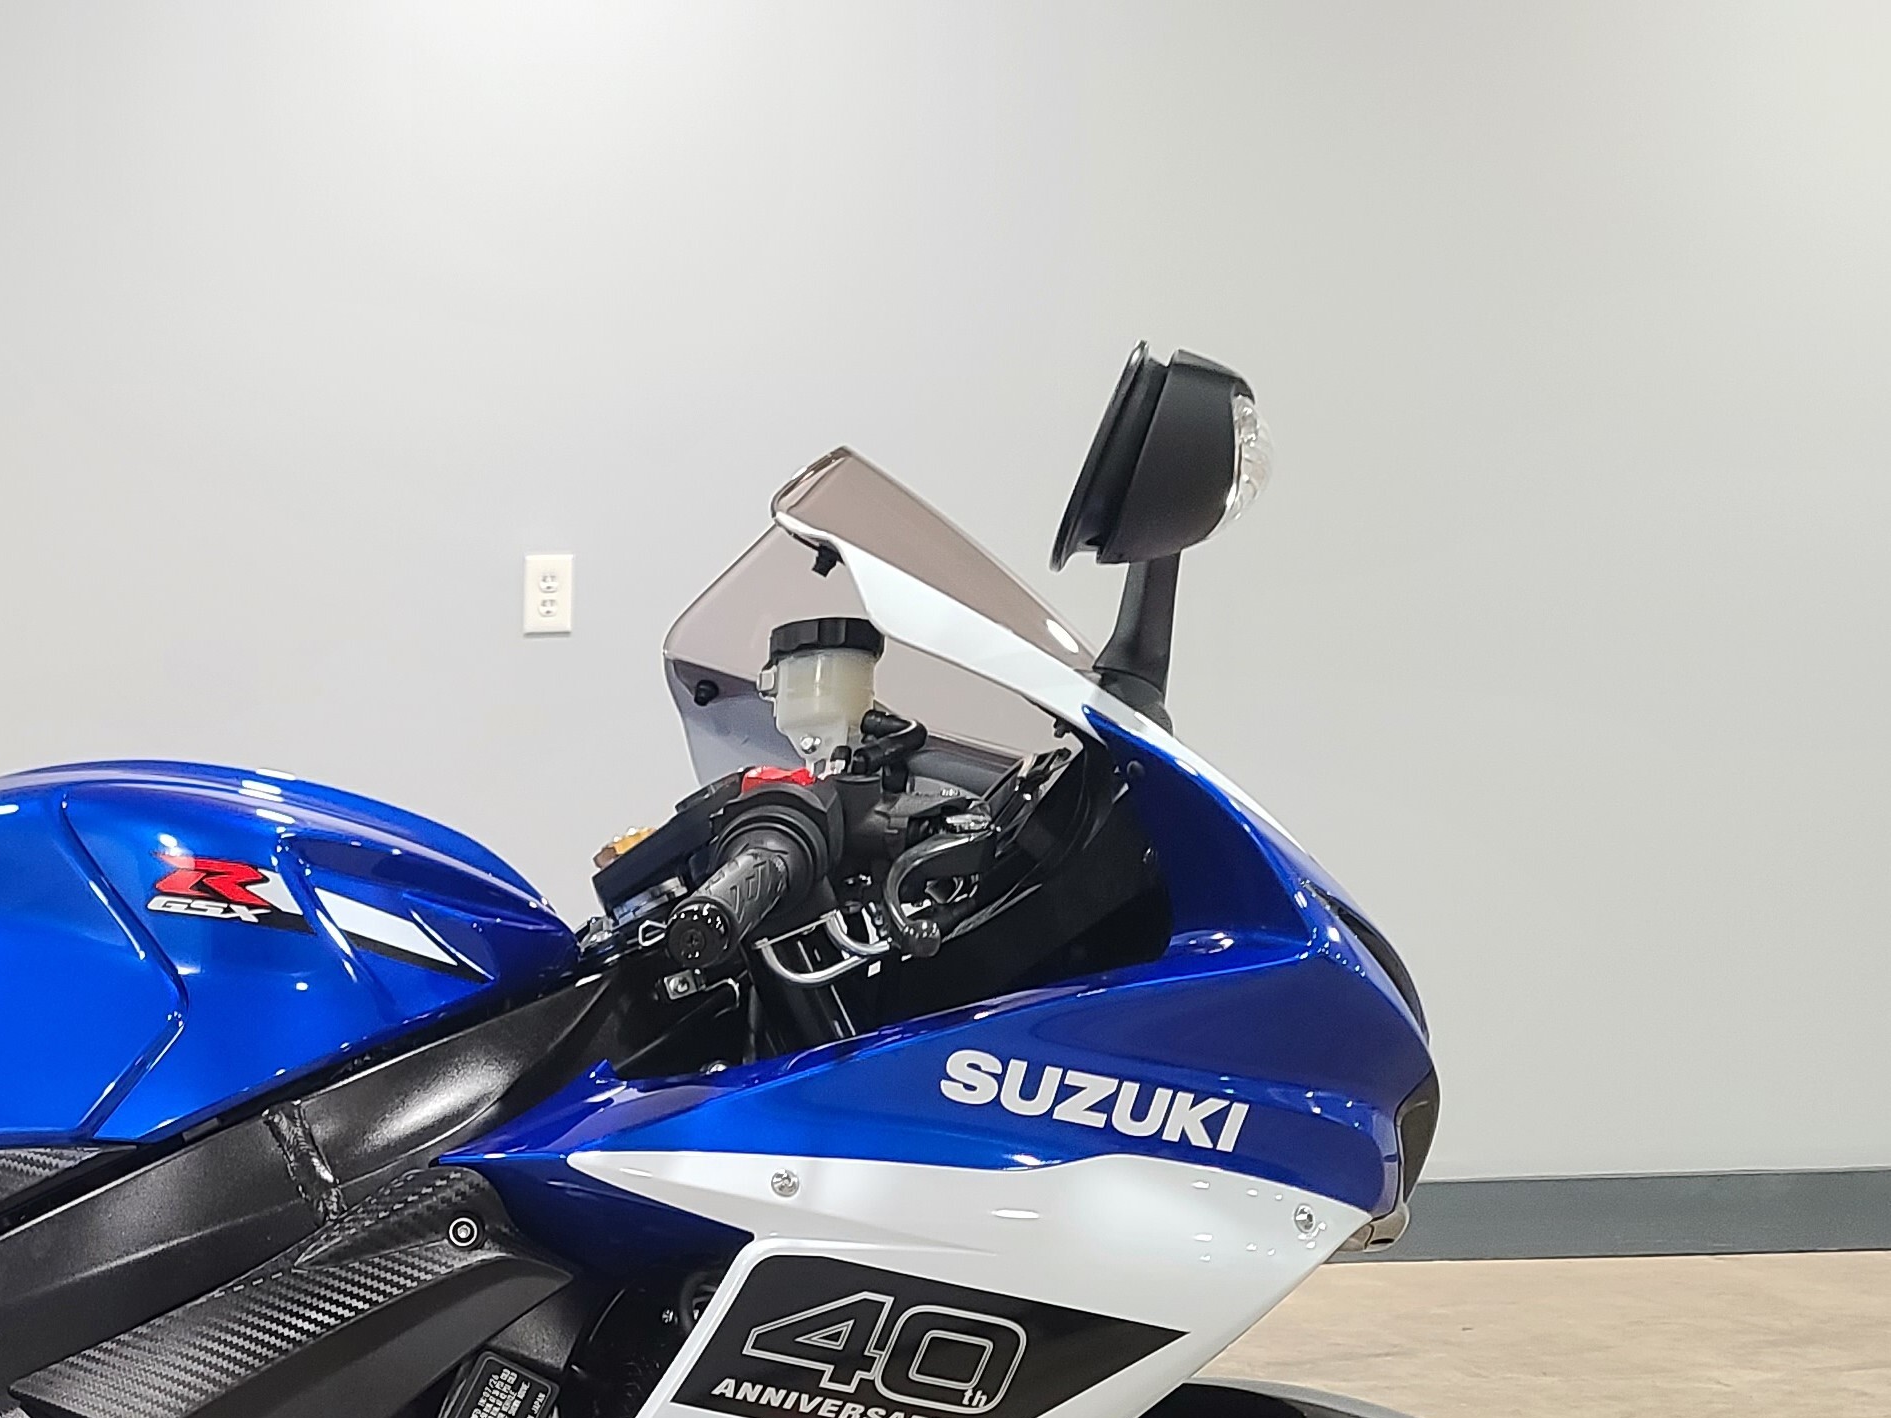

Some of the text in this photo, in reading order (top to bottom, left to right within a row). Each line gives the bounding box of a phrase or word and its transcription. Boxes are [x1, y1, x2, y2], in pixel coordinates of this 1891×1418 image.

[147, 895, 272, 923] GSX
[940, 1049, 1250, 1152] SUZUKI
[529, 1392, 546, 1414] JAPAN
